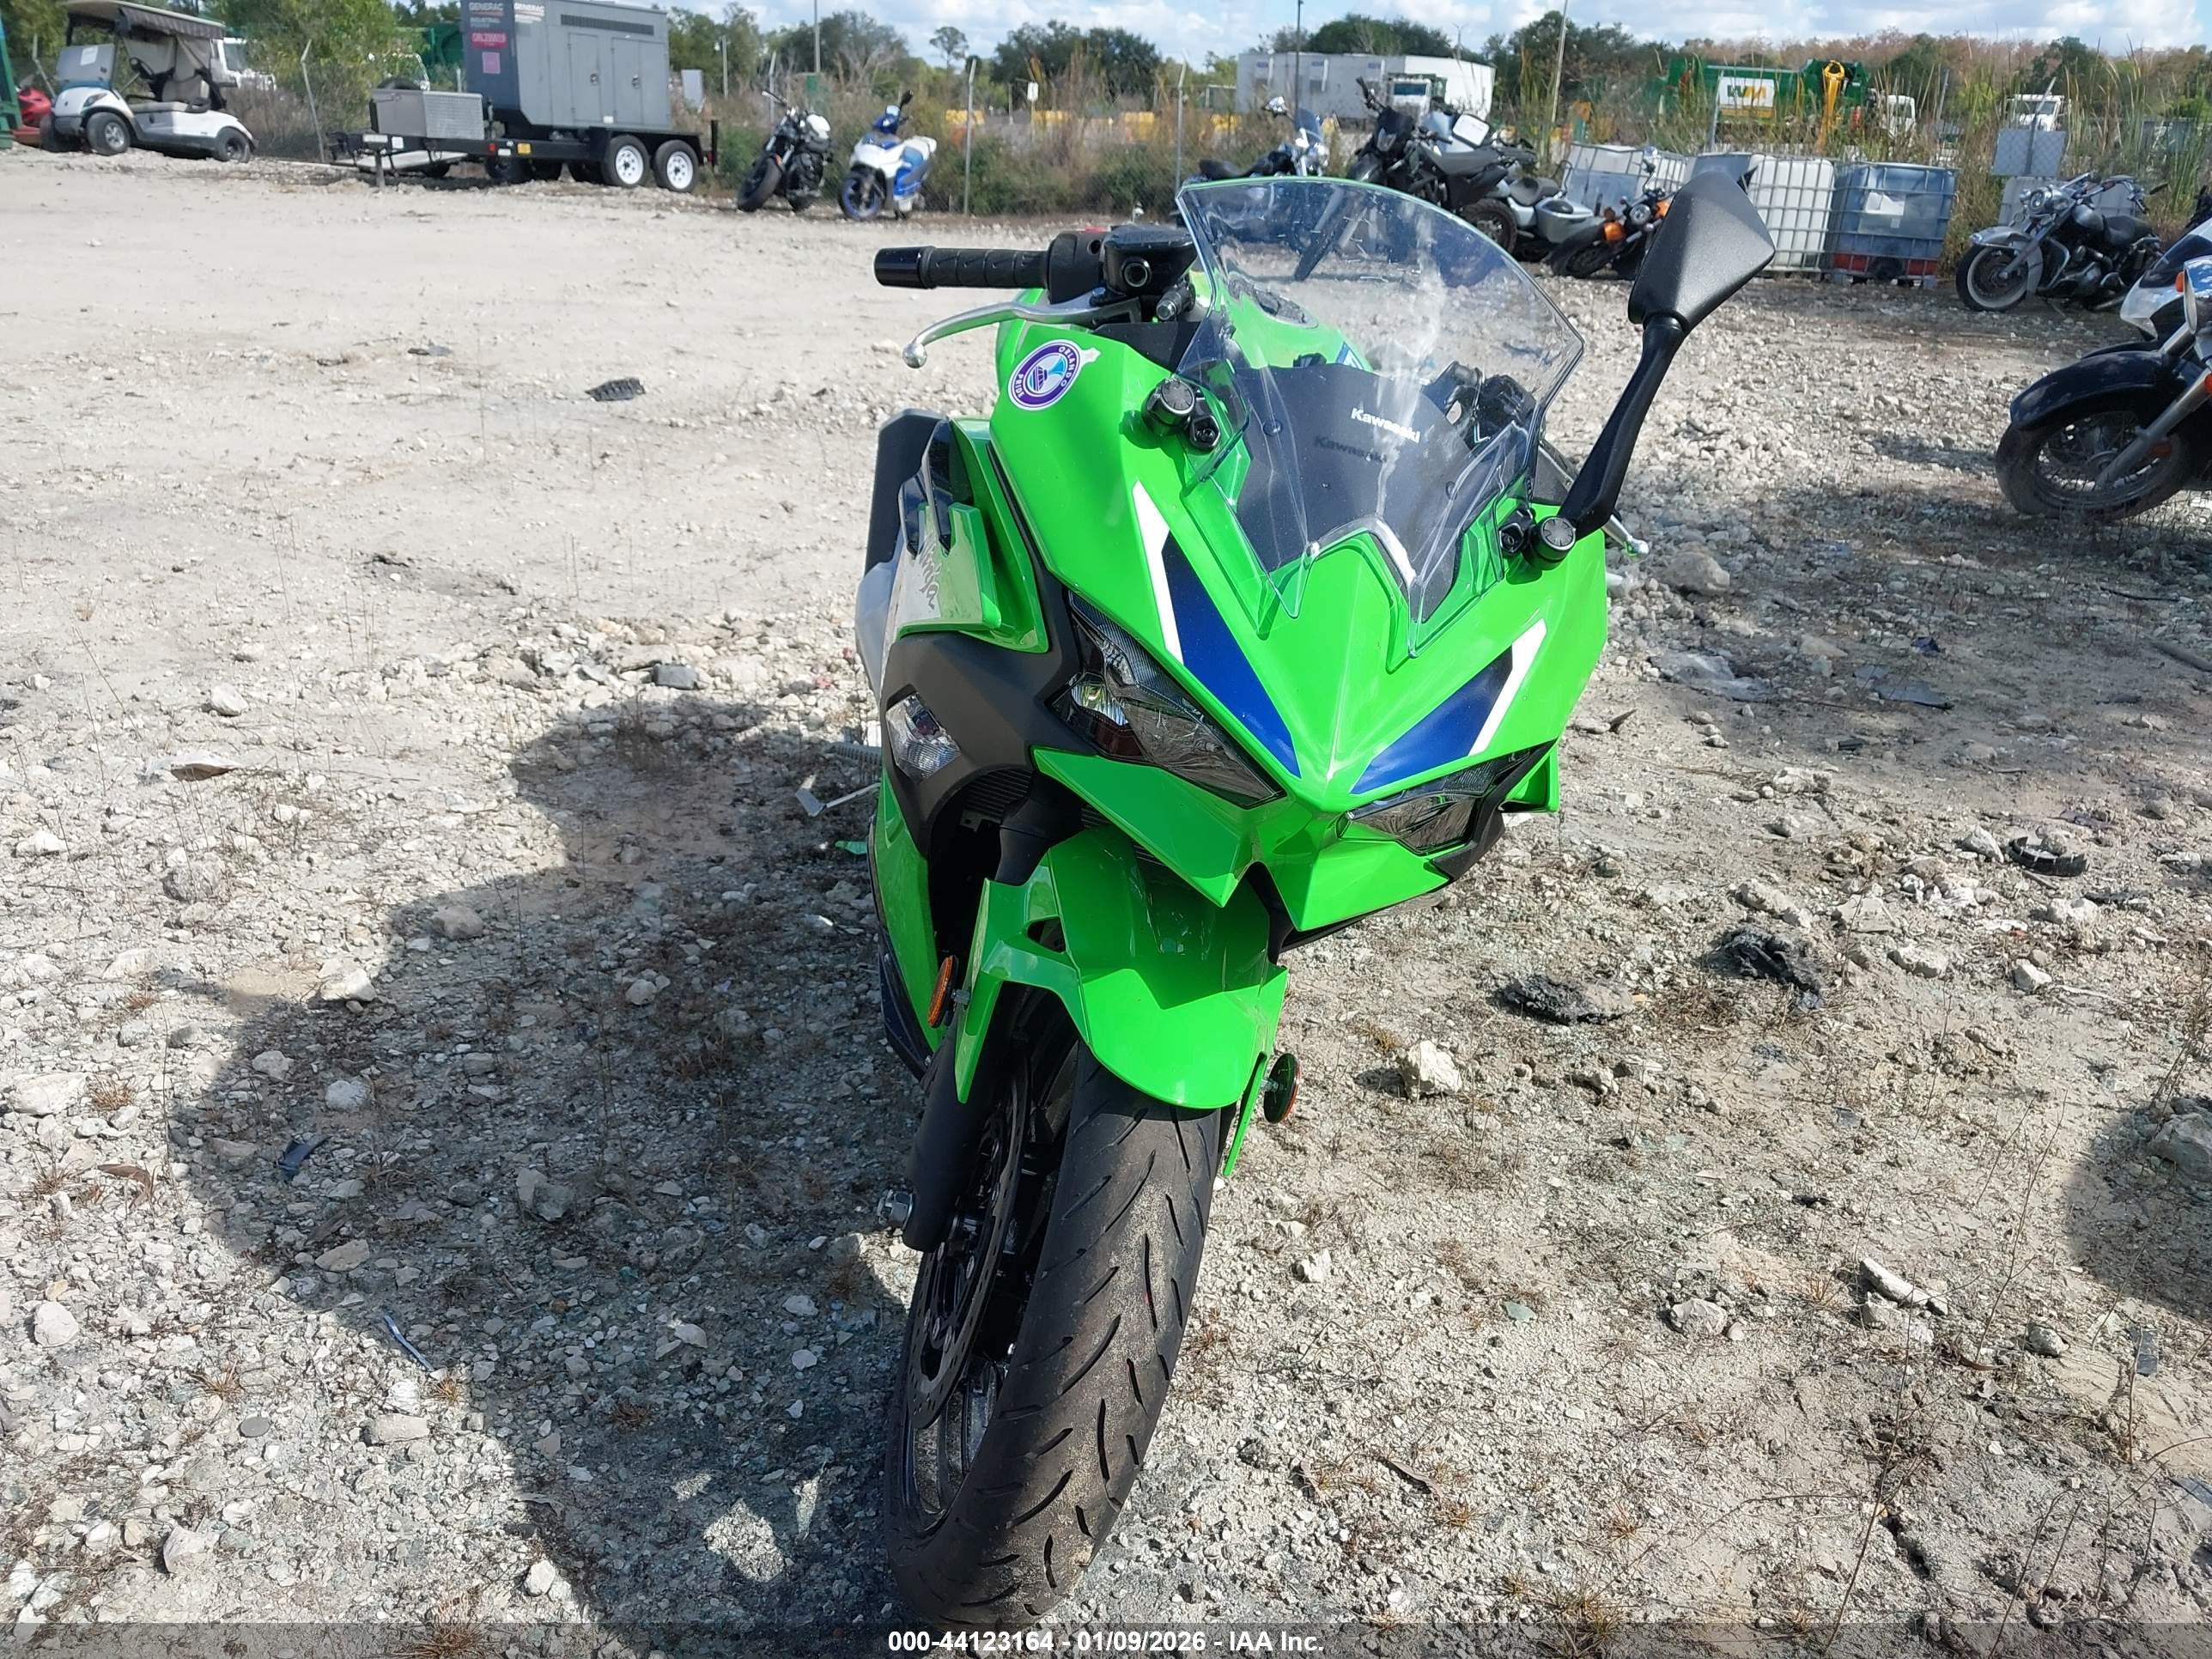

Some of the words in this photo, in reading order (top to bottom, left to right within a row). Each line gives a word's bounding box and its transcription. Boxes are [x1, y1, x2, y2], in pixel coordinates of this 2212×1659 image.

[1058, 346, 1076, 387] ORLANDO
[1015, 374, 1025, 398] PRIDE
[1350, 407, 1421, 444] Kawasaki
